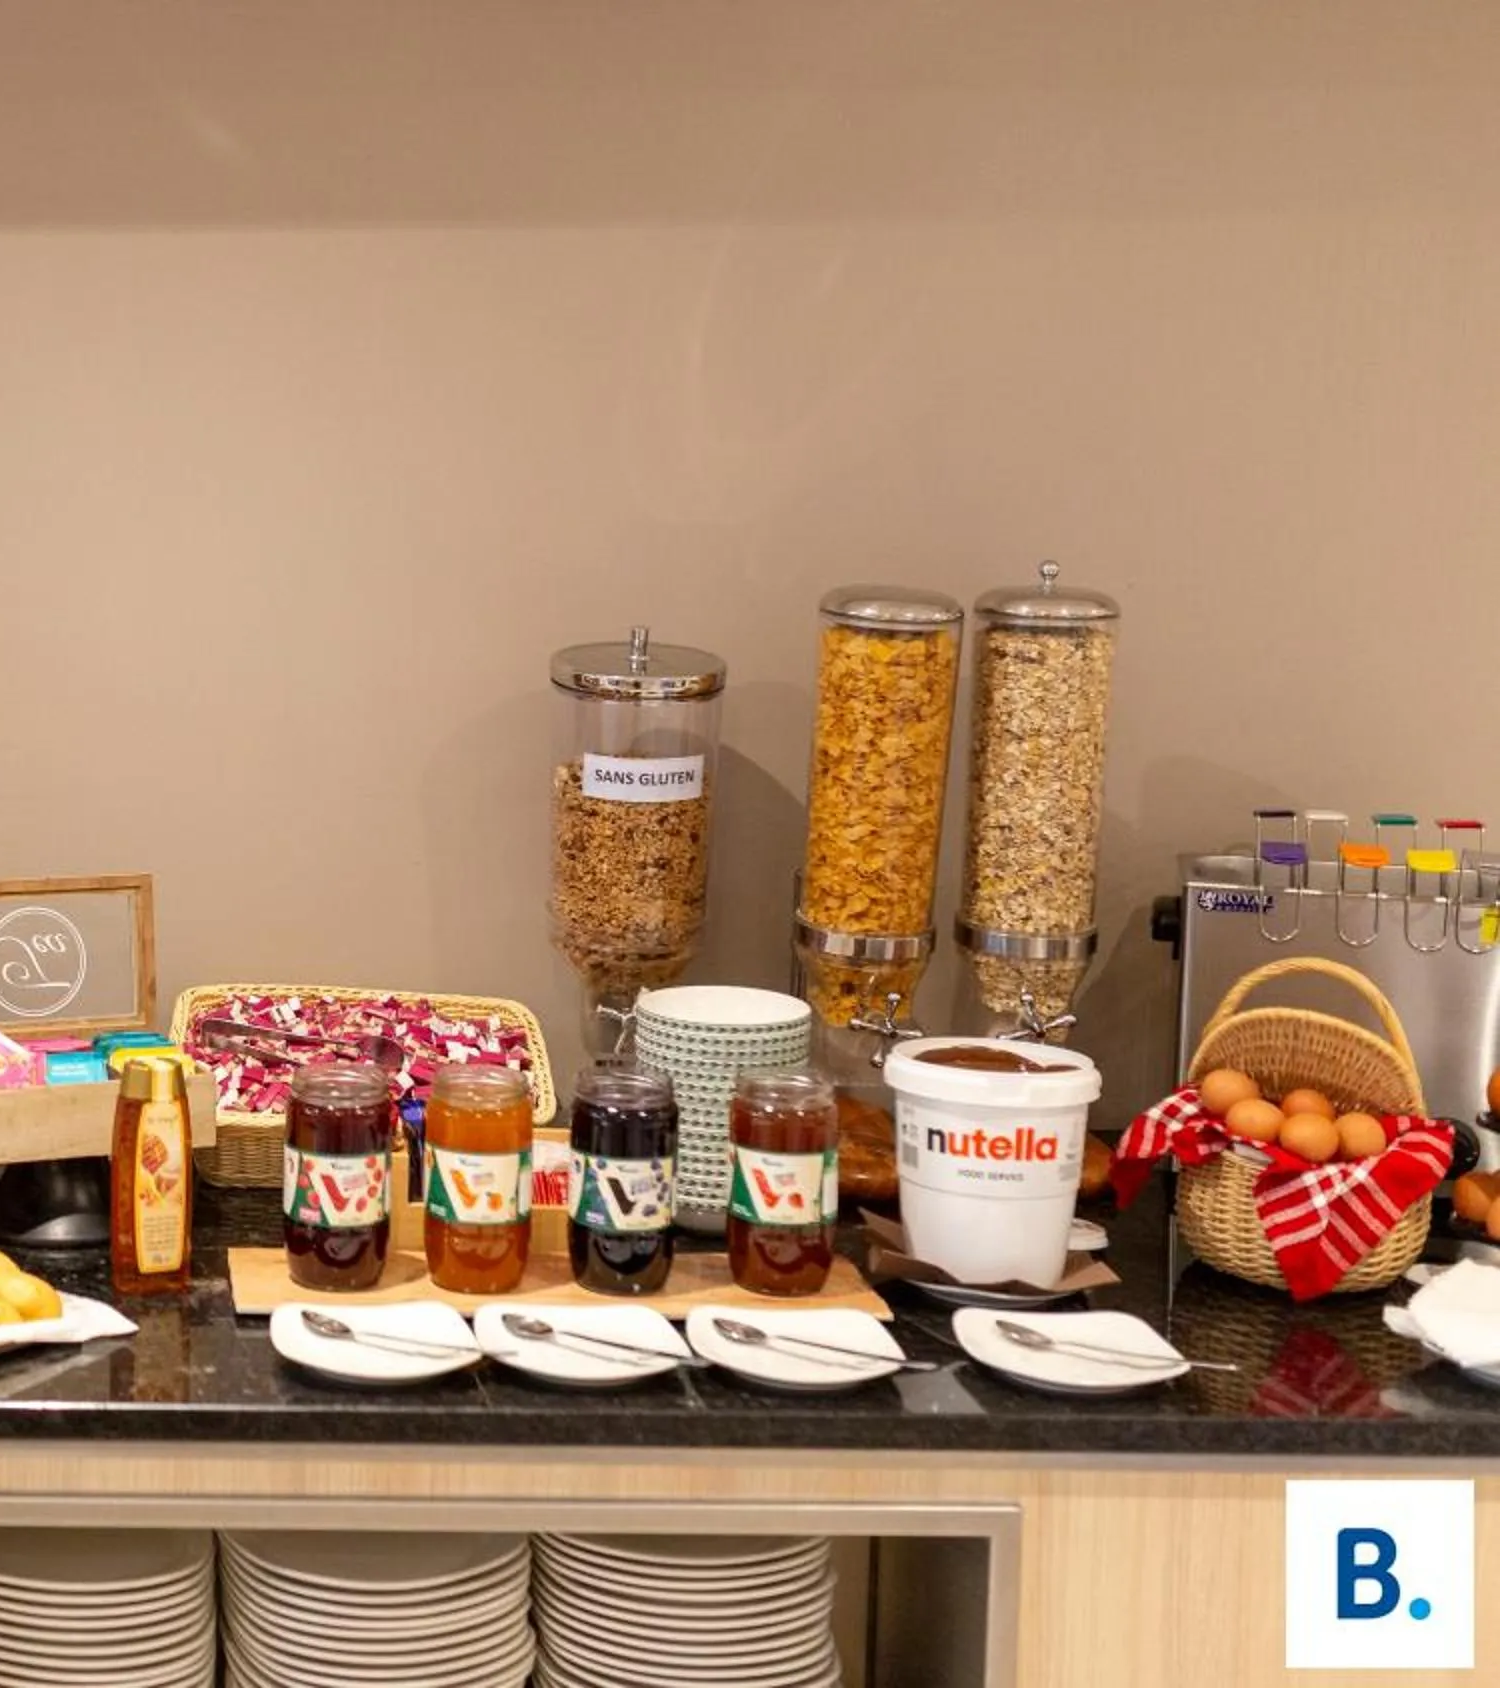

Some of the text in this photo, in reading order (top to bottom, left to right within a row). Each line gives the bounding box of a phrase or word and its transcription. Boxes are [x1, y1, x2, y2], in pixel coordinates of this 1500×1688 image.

[594, 769, 695, 786] SANS GLUTEN
[927, 1127, 1058, 1162] nutella
